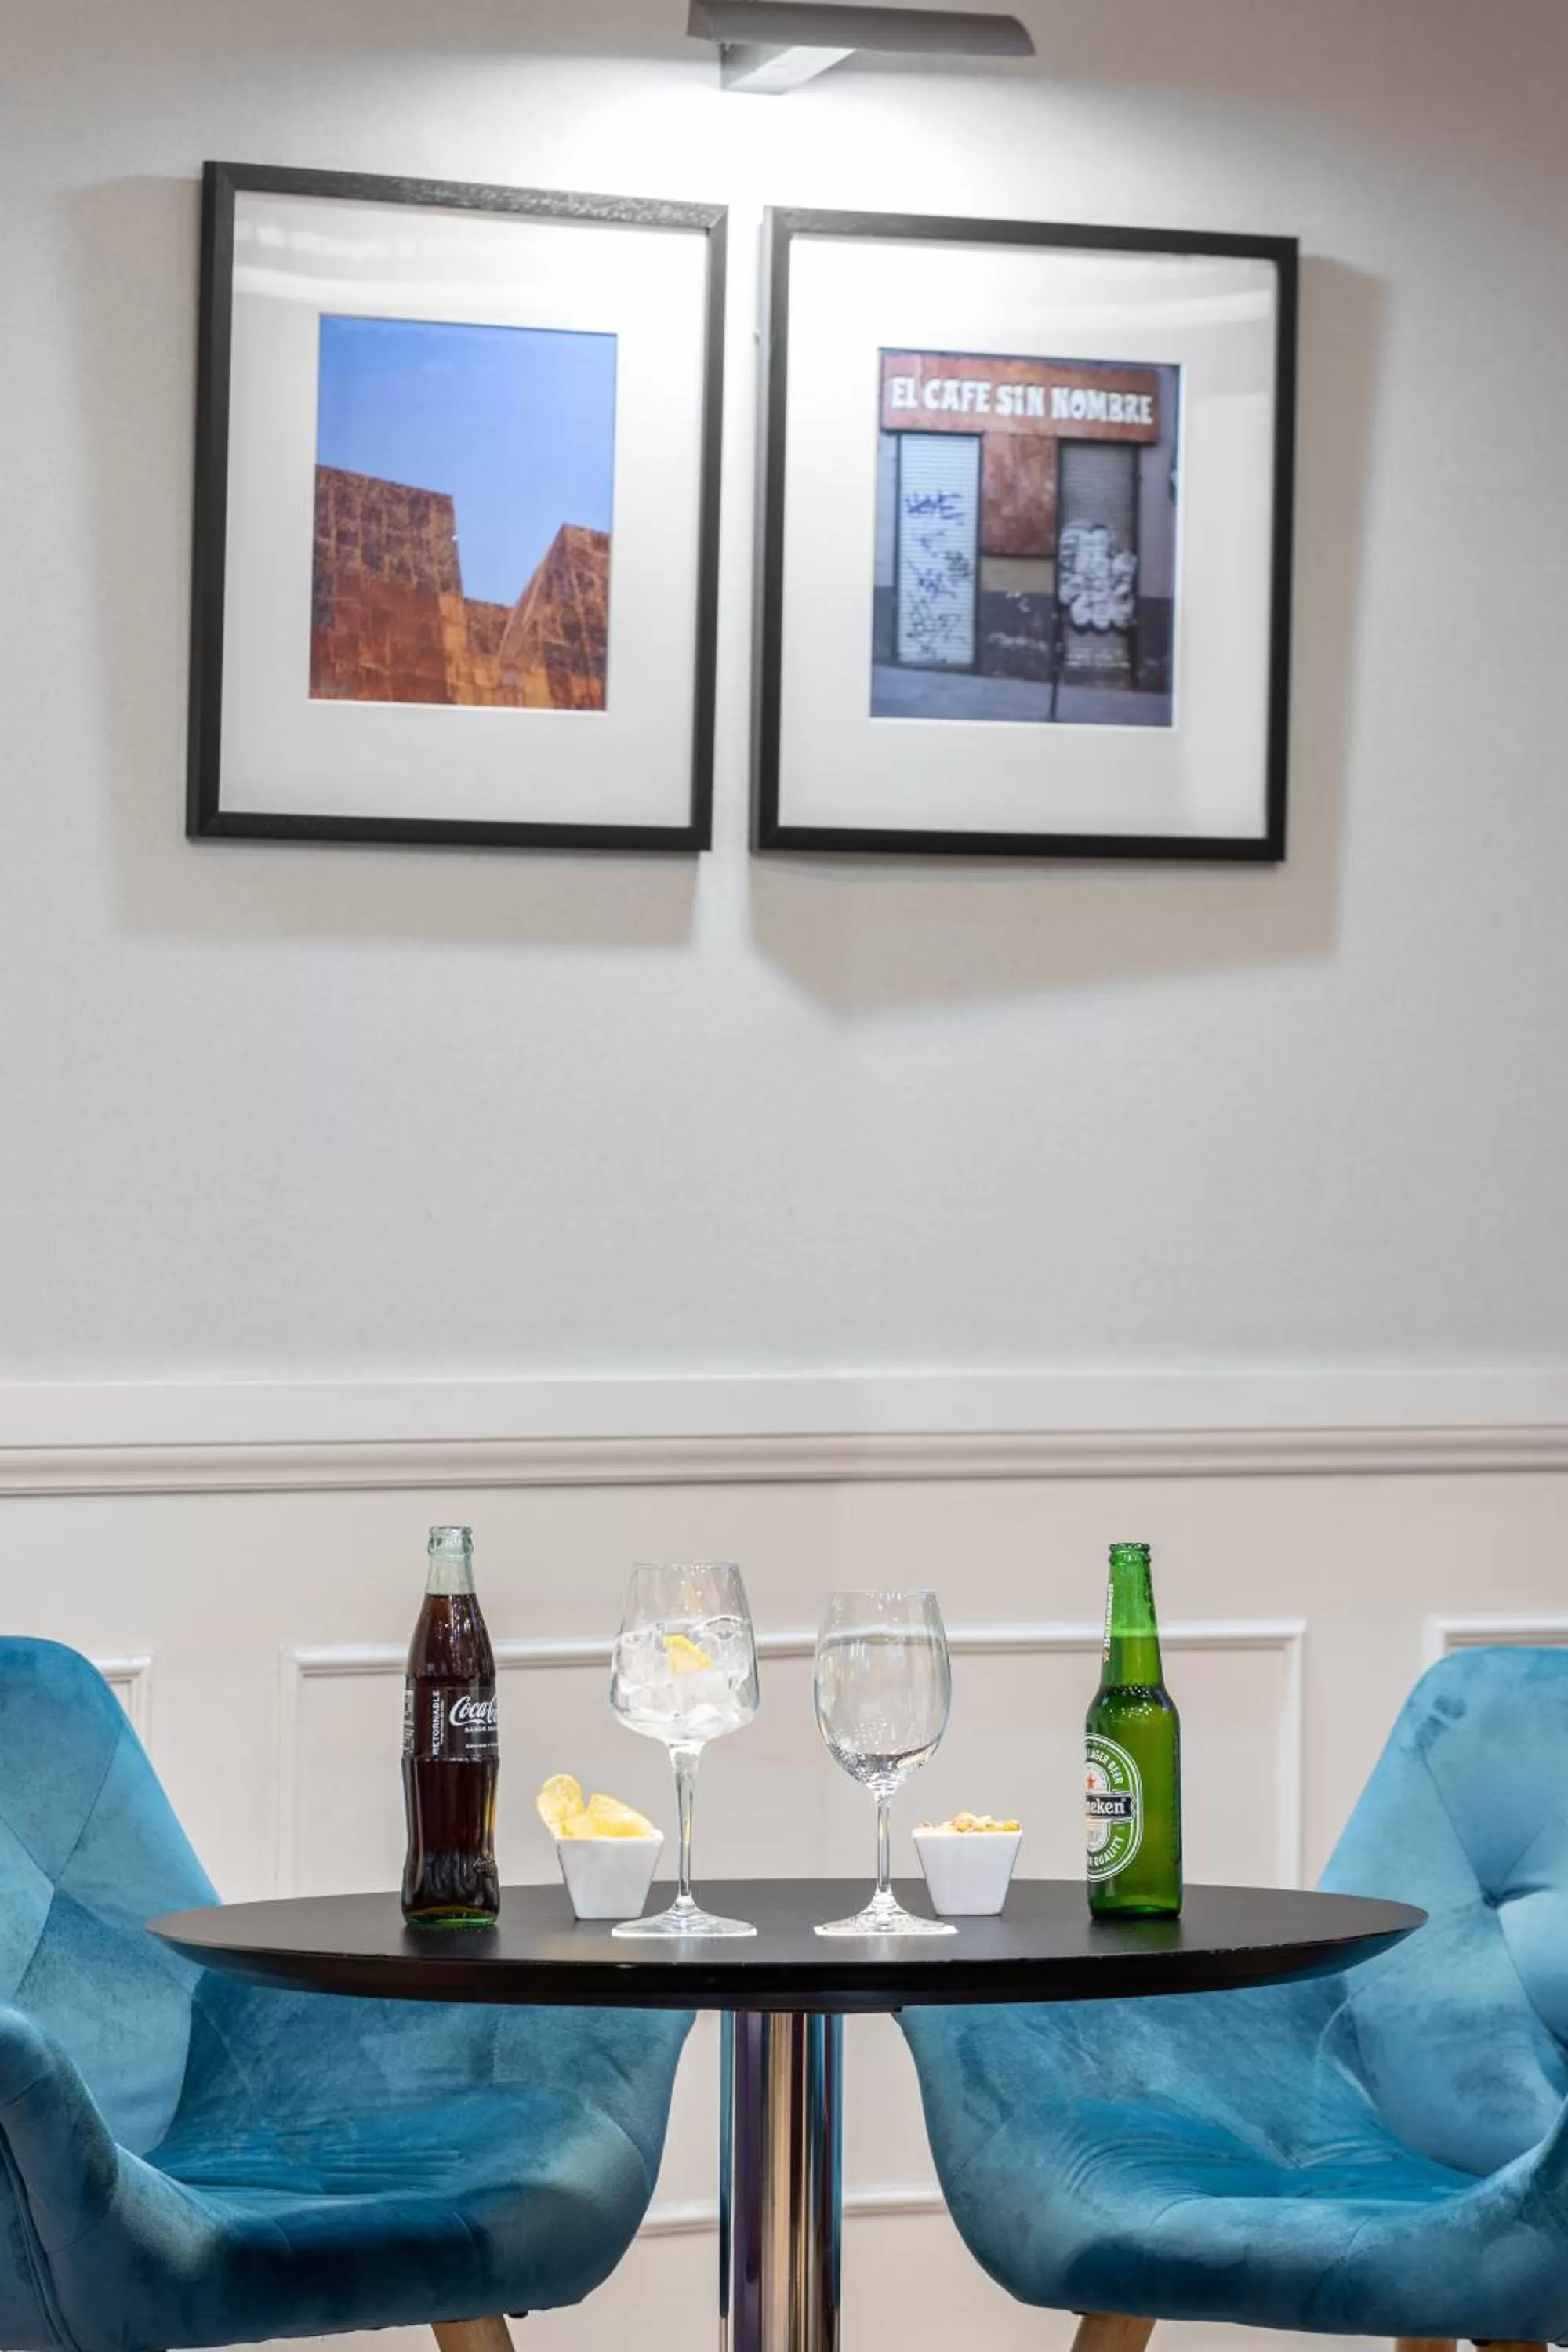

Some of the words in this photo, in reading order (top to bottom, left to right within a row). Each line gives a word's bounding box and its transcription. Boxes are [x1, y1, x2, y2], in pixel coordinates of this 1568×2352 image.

[892, 377, 917, 408] EL
[924, 379, 992, 412] CAFE
[1051, 387, 1154, 424] NOMBRE
[1087, 1798, 1126, 1815] eken
